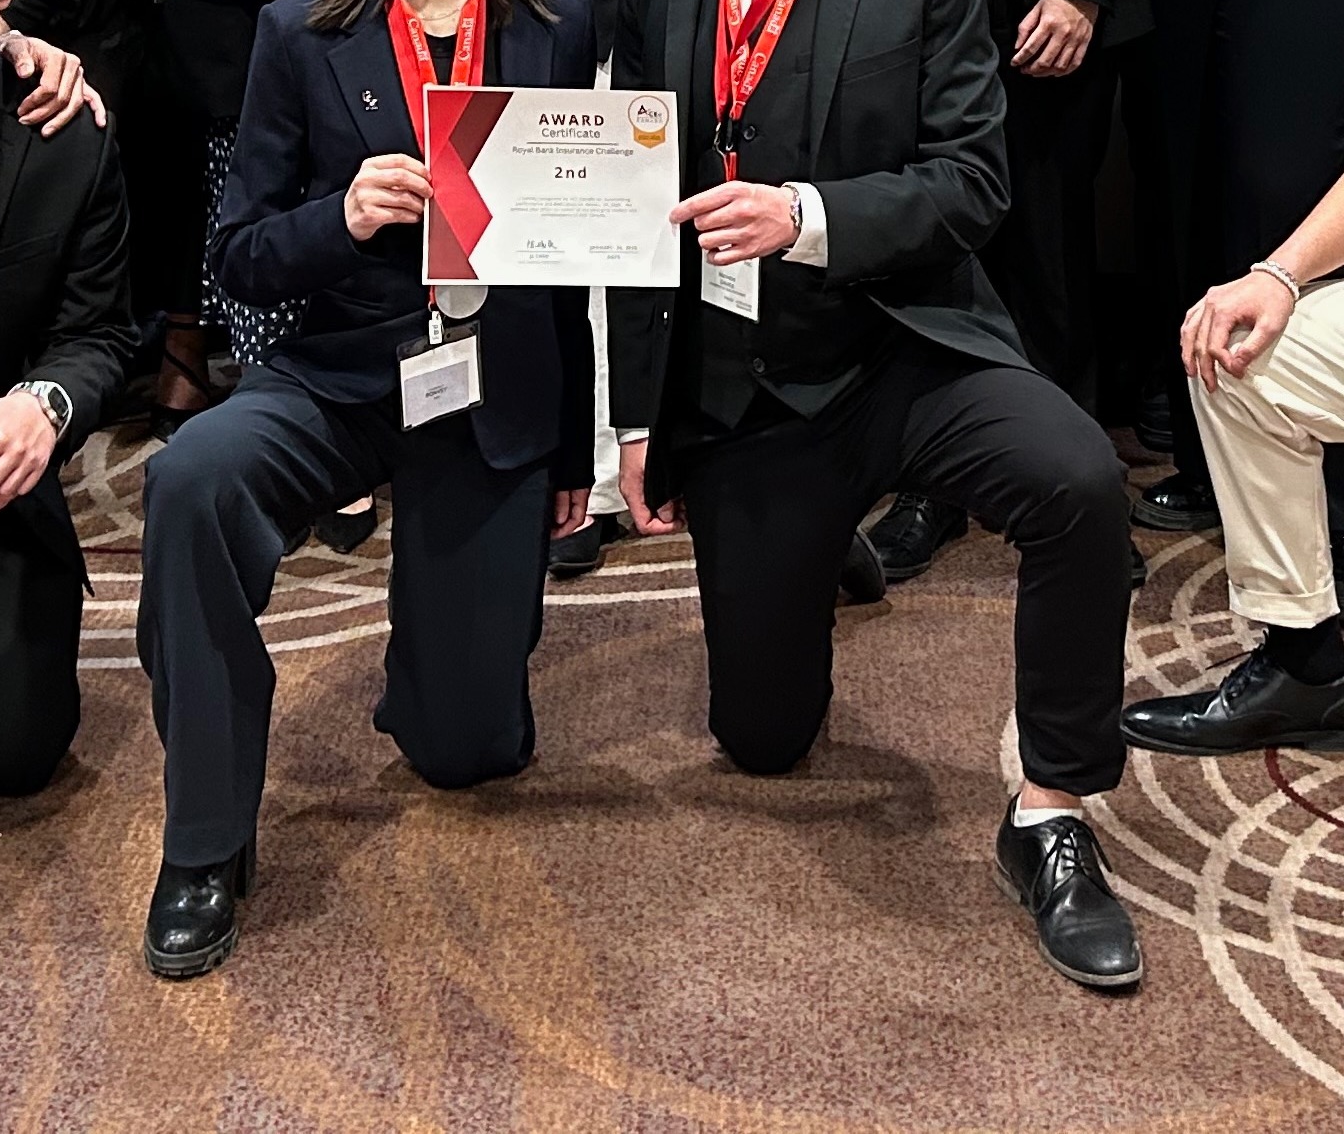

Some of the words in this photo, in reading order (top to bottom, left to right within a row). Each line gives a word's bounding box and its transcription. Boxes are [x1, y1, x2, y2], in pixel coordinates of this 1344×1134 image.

[408, 18, 431, 62] Canada
[457, 18, 475, 62] Canada
[740, 52, 767, 95] Canada
[539, 114, 605, 126] AWARD
[541, 128, 601, 139] Certificate
[512, 146, 534, 155] Royal
[556, 147, 594, 155] Insurance
[595, 147, 634, 157] Challenge
[554, 166, 587, 179] 2nd
